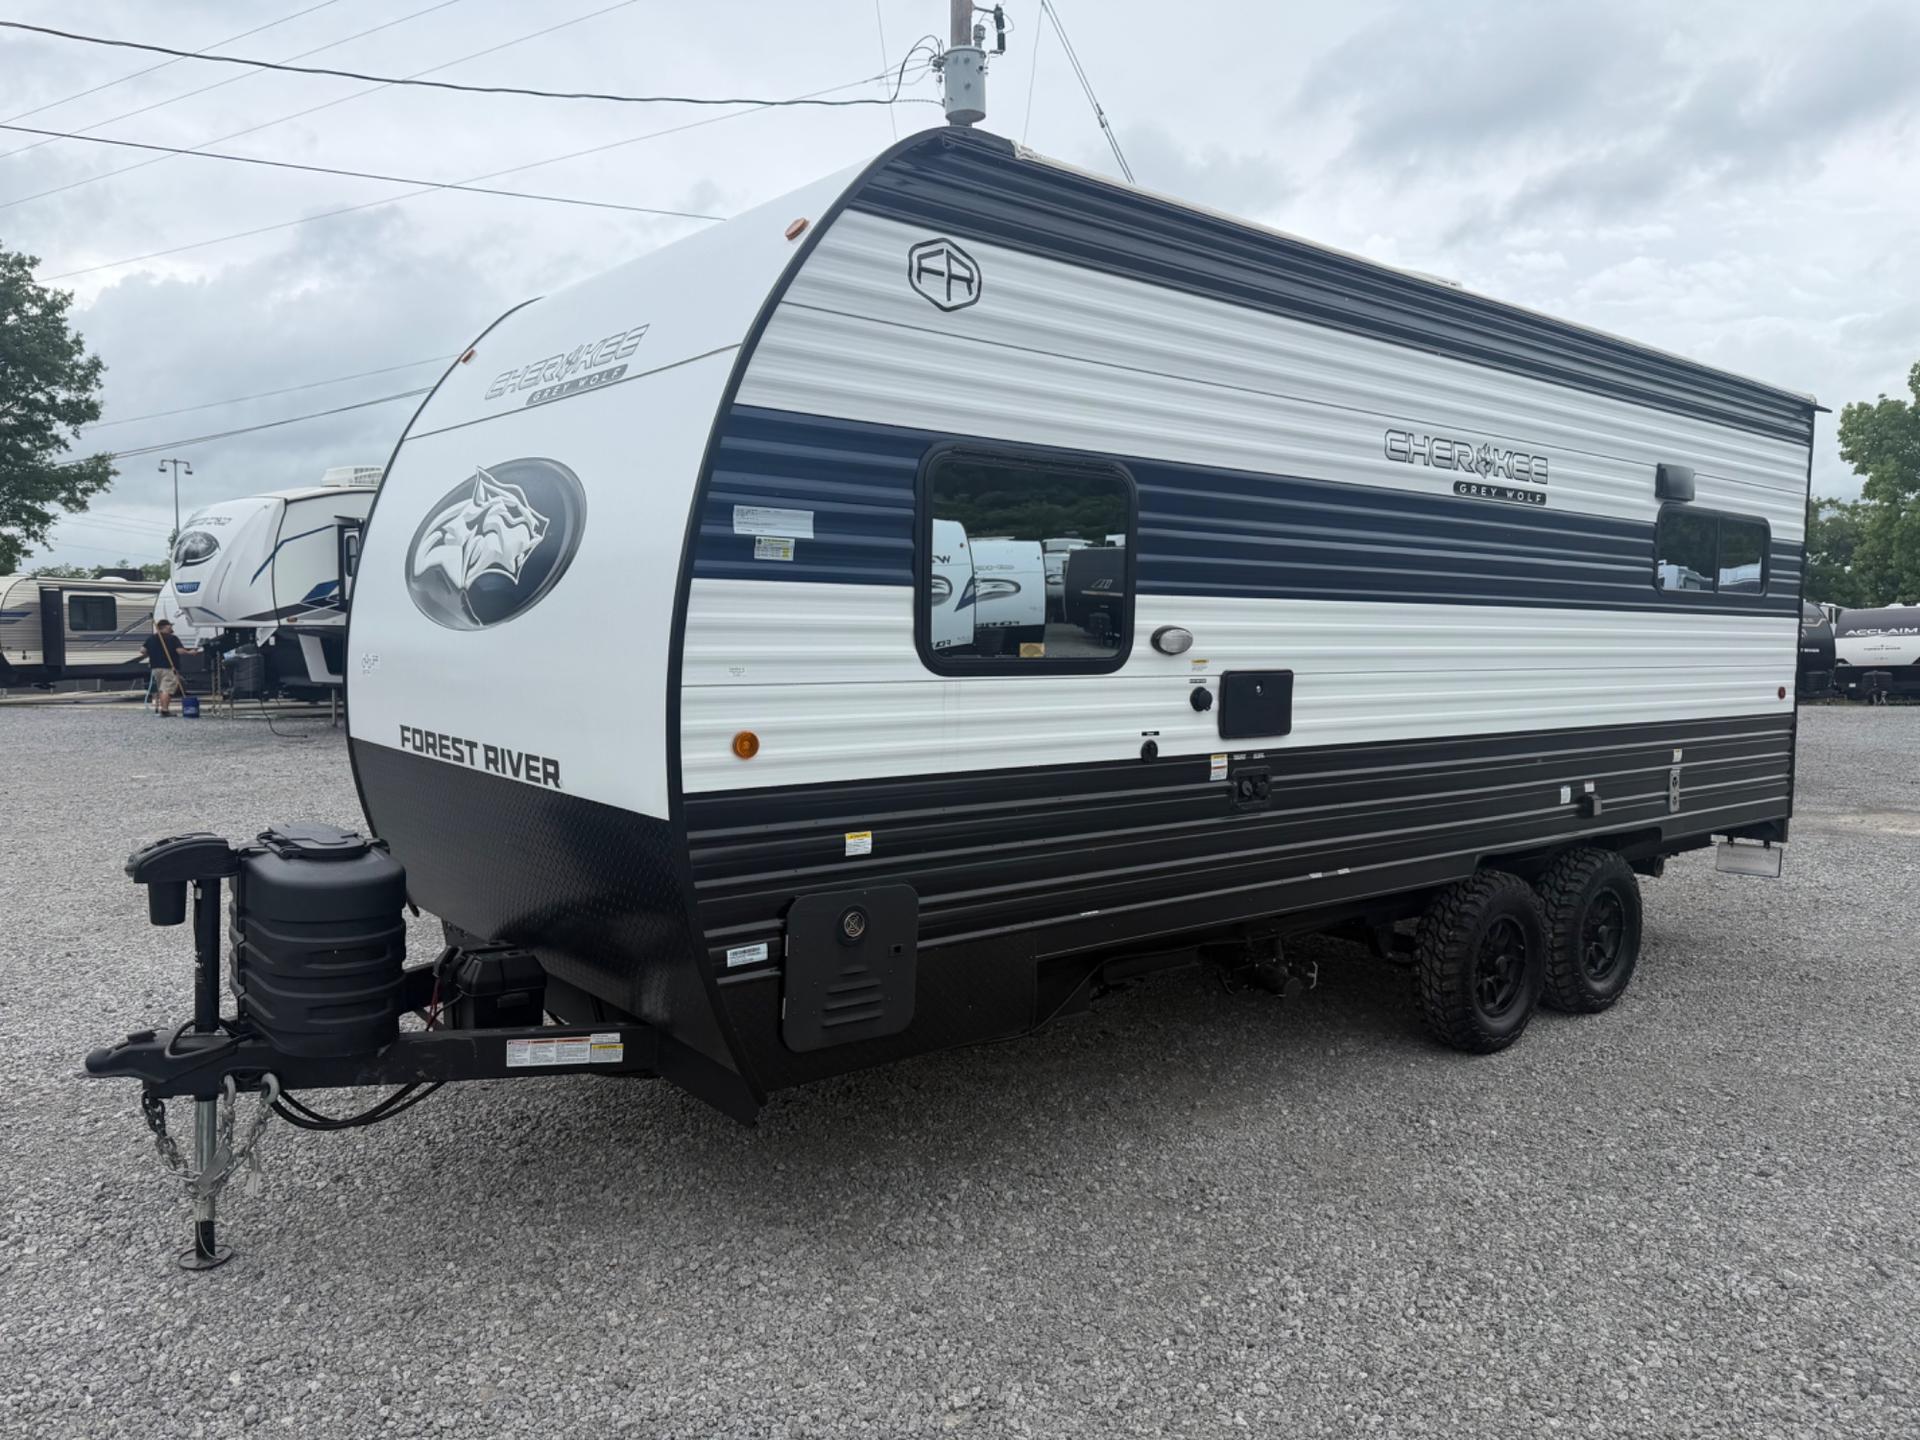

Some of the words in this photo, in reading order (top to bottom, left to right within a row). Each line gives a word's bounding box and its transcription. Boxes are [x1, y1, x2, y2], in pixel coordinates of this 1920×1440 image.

[531, 382, 571, 402] GREY
[578, 366, 622, 387] WOLF
[1458, 483, 1498, 498] GREY
[1505, 487, 1543, 503] WOLF
[1845, 627, 1919, 637] ACCLAIM
[399, 724, 478, 767] FOREST
[482, 743, 561, 789] RIVER
